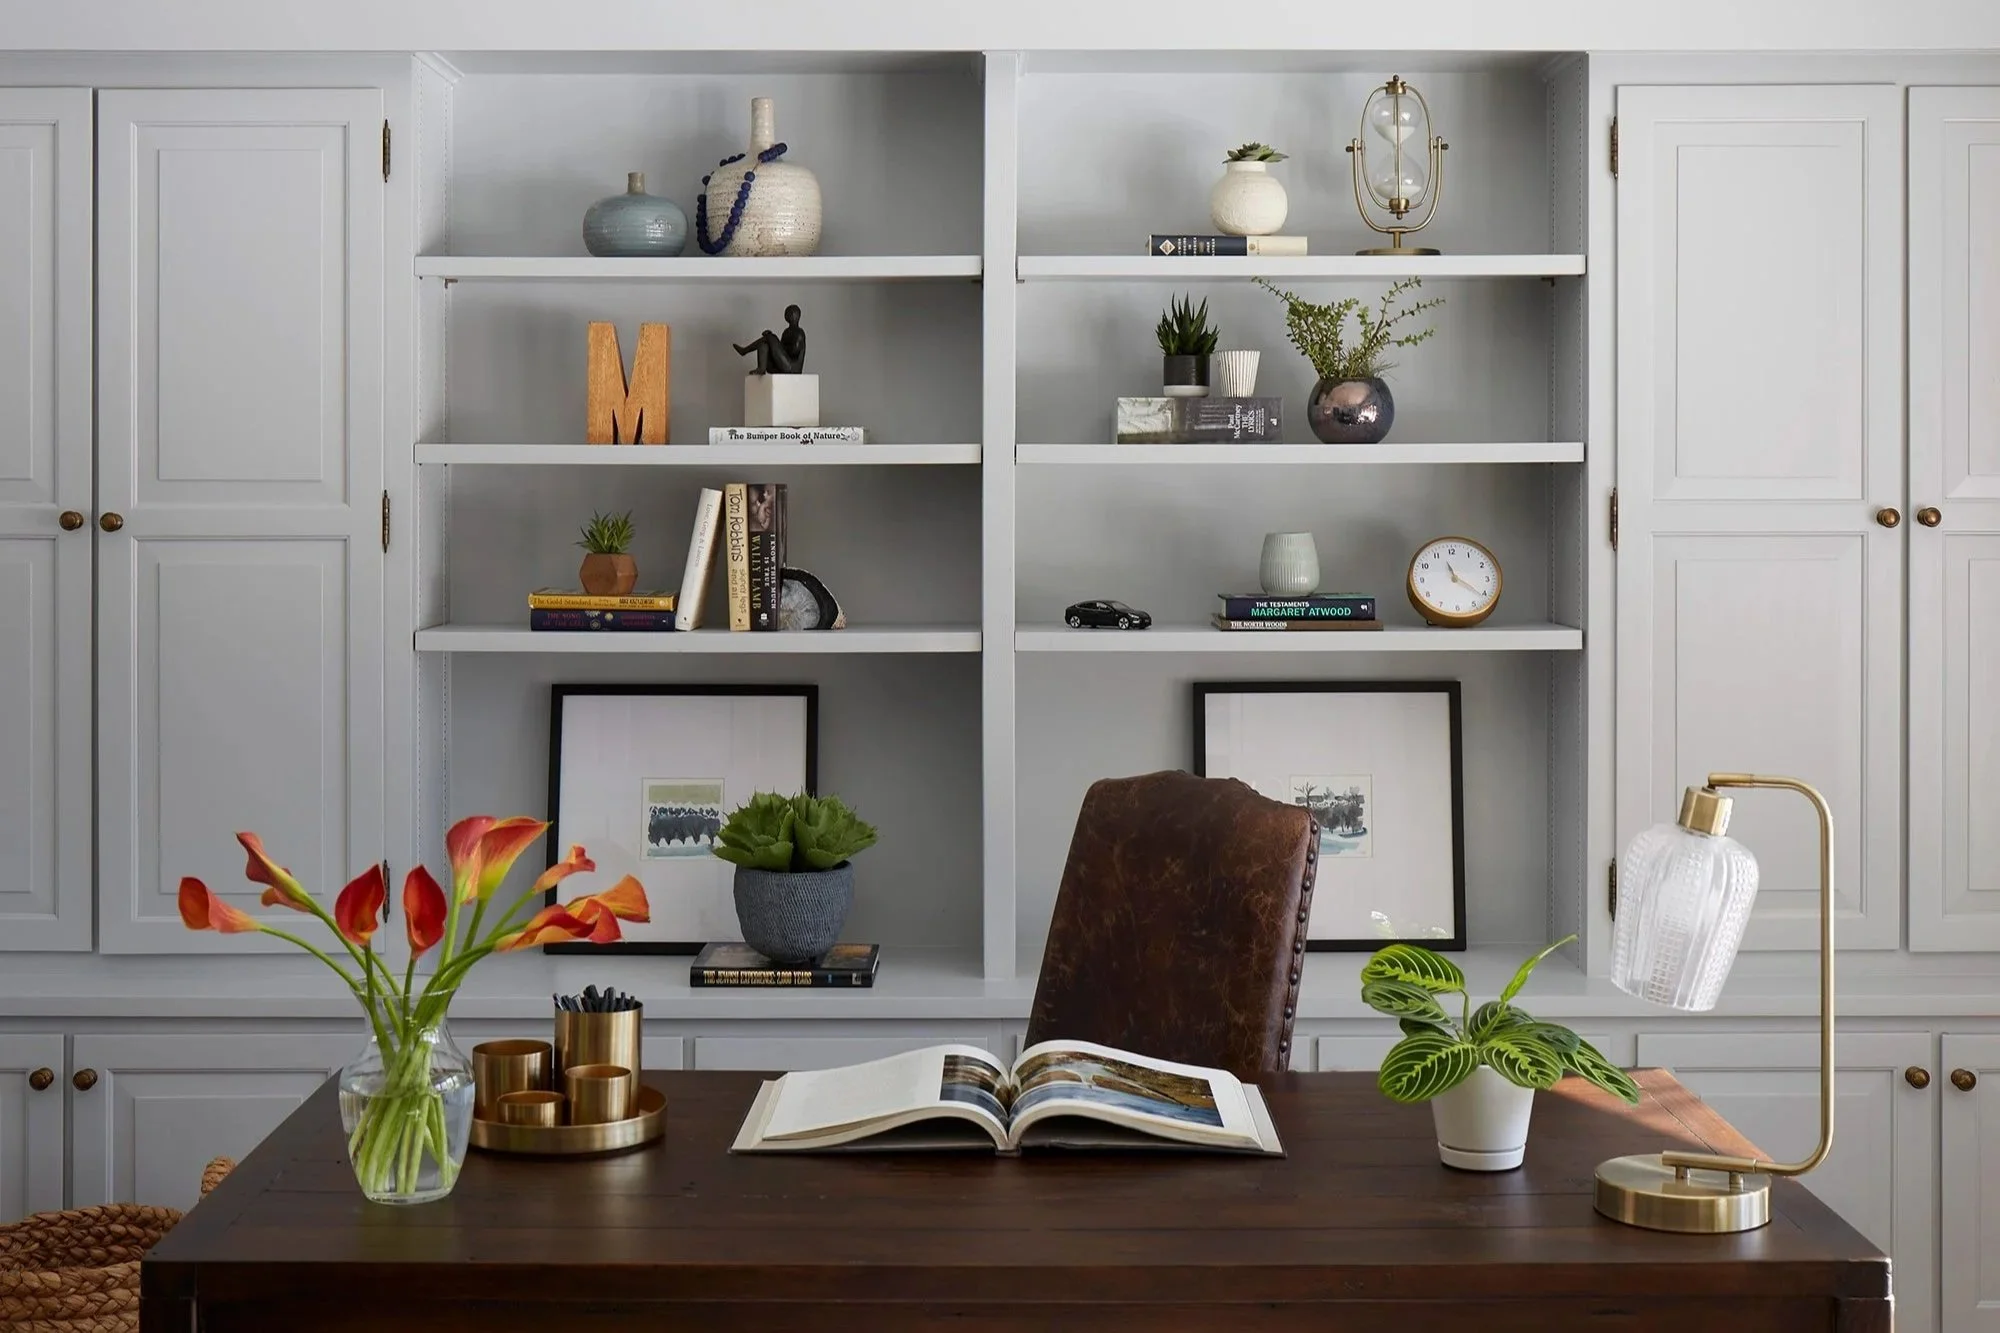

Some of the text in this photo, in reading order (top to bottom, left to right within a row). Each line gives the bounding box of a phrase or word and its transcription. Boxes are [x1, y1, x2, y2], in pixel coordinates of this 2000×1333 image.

[587, 321, 670, 444] M
[1227, 414, 1235, 429] Paul
[1234, 403, 1243, 439] McCartney
[729, 431, 841, 441] The Bumper Book of Nature
[729, 488, 744, 562] Tom Robbins
[764, 556, 770, 564] IS
[752, 535, 761, 609] WALLY LAMB
[739, 568, 747, 594] skinny
[533, 597, 546, 605] The
[564, 598, 592, 606] Standard
[739, 596, 748, 614] legs
[1251, 607, 1352, 617] MARGARET ATWOOD
[1265, 621, 1288, 629] WOODS
[703, 970, 715, 984] THE
[716, 970, 739, 984] JEWISH
[740, 970, 776, 985] EXPERIENCE:
[777, 970, 792, 985] 2,000
[793, 970, 812, 985] YEARS
